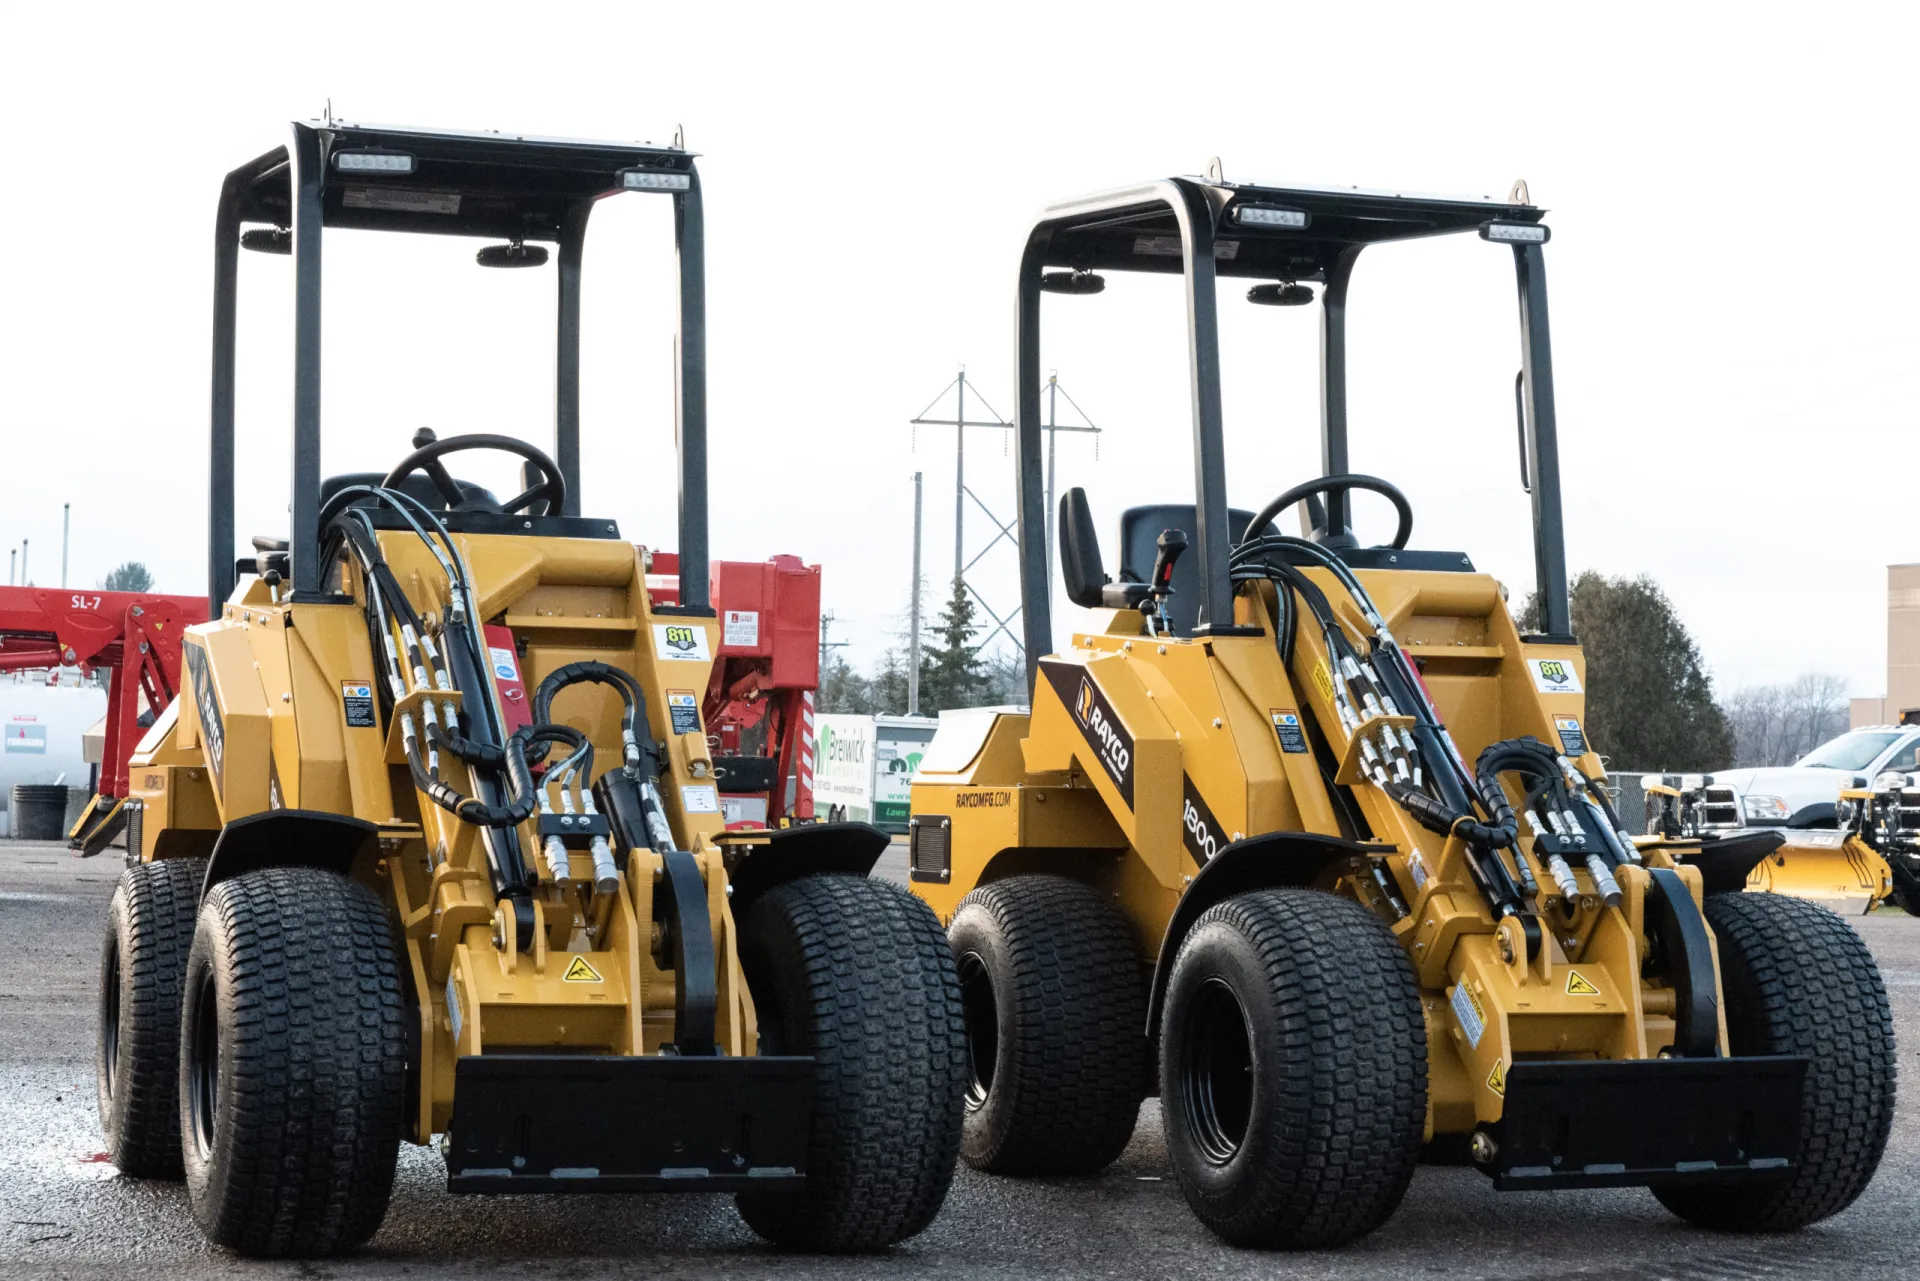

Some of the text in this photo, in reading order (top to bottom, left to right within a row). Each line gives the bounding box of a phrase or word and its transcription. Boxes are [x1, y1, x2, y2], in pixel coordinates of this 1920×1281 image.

[71, 594, 102, 610] SL-7
[666, 627, 694, 643] 811
[1539, 661, 1565, 676] 811
[1090, 706, 1129, 771] RAYCO
[955, 791, 1012, 808] RAYCOMFG.COM
[1184, 799, 1216, 860] 1800
